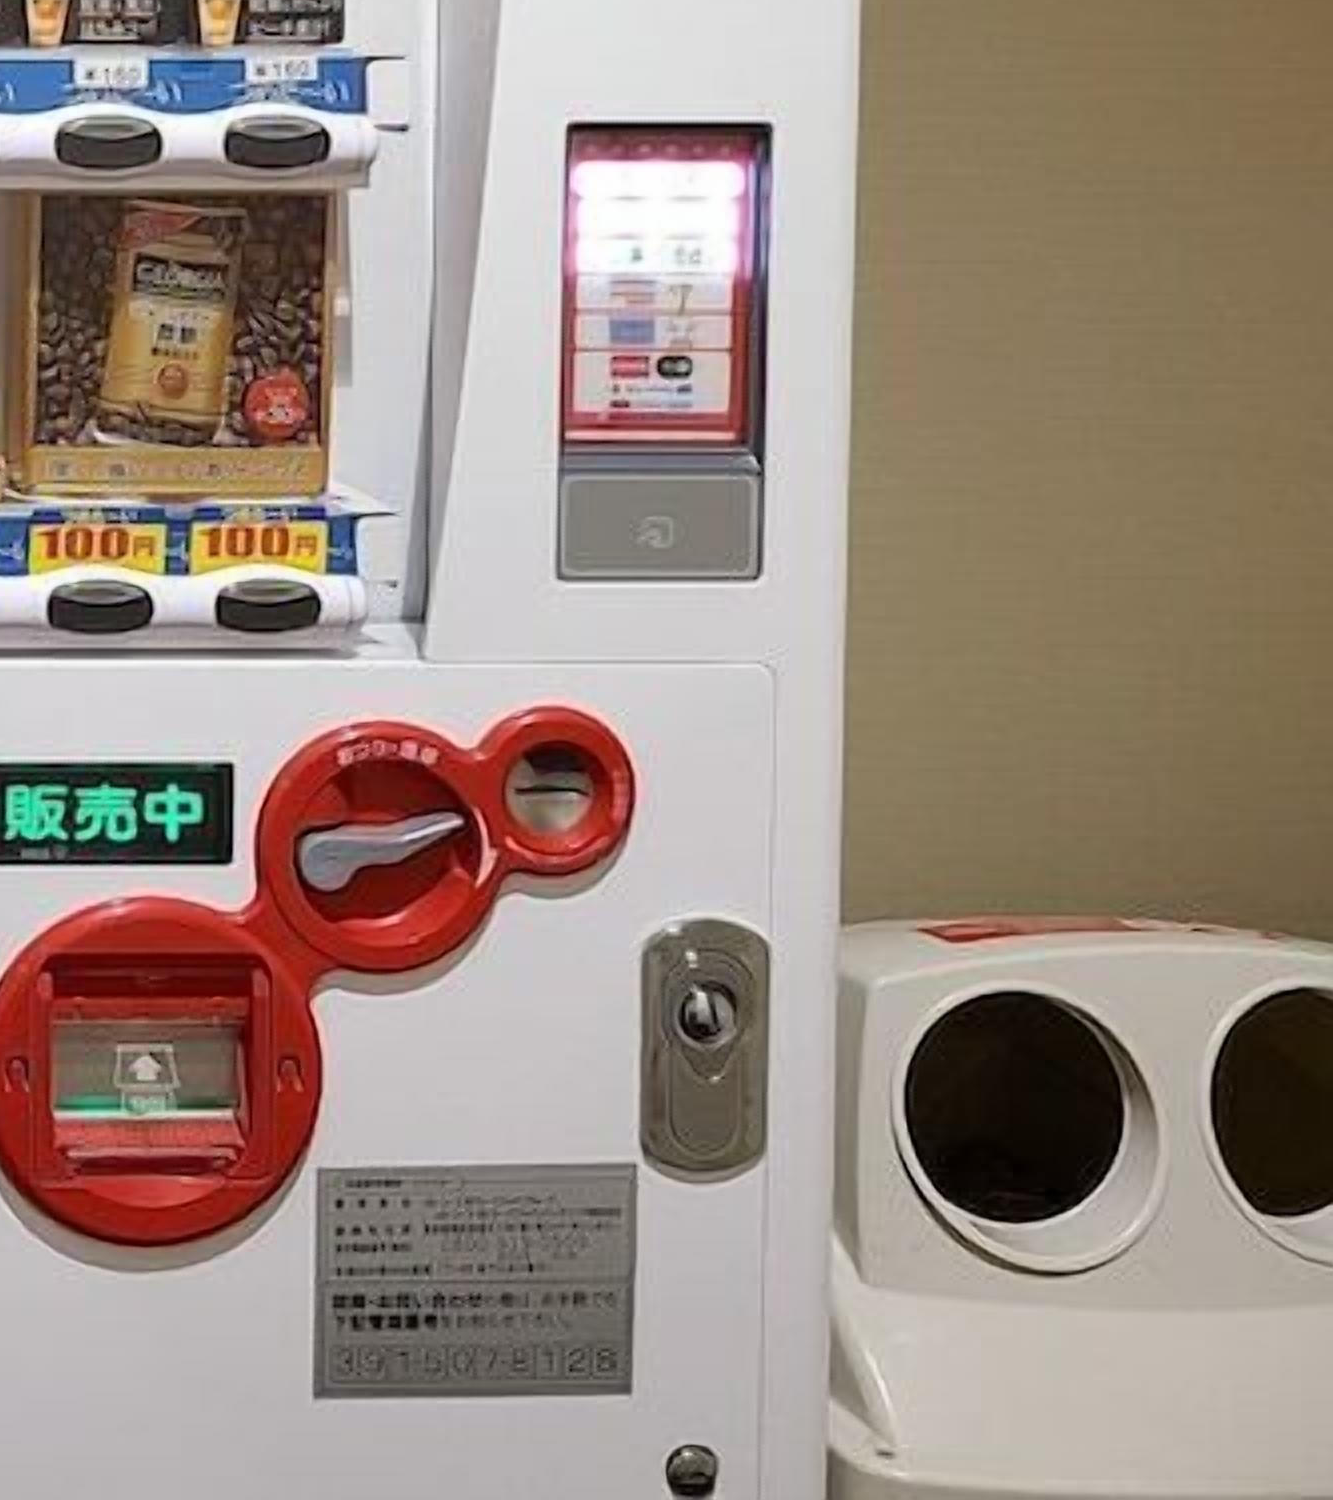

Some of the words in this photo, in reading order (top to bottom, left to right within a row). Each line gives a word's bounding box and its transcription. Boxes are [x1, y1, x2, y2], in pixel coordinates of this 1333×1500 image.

[39, 527, 156, 560] 100円
[202, 526, 318, 559] 100円
[4, 783, 206, 843] 販売中
